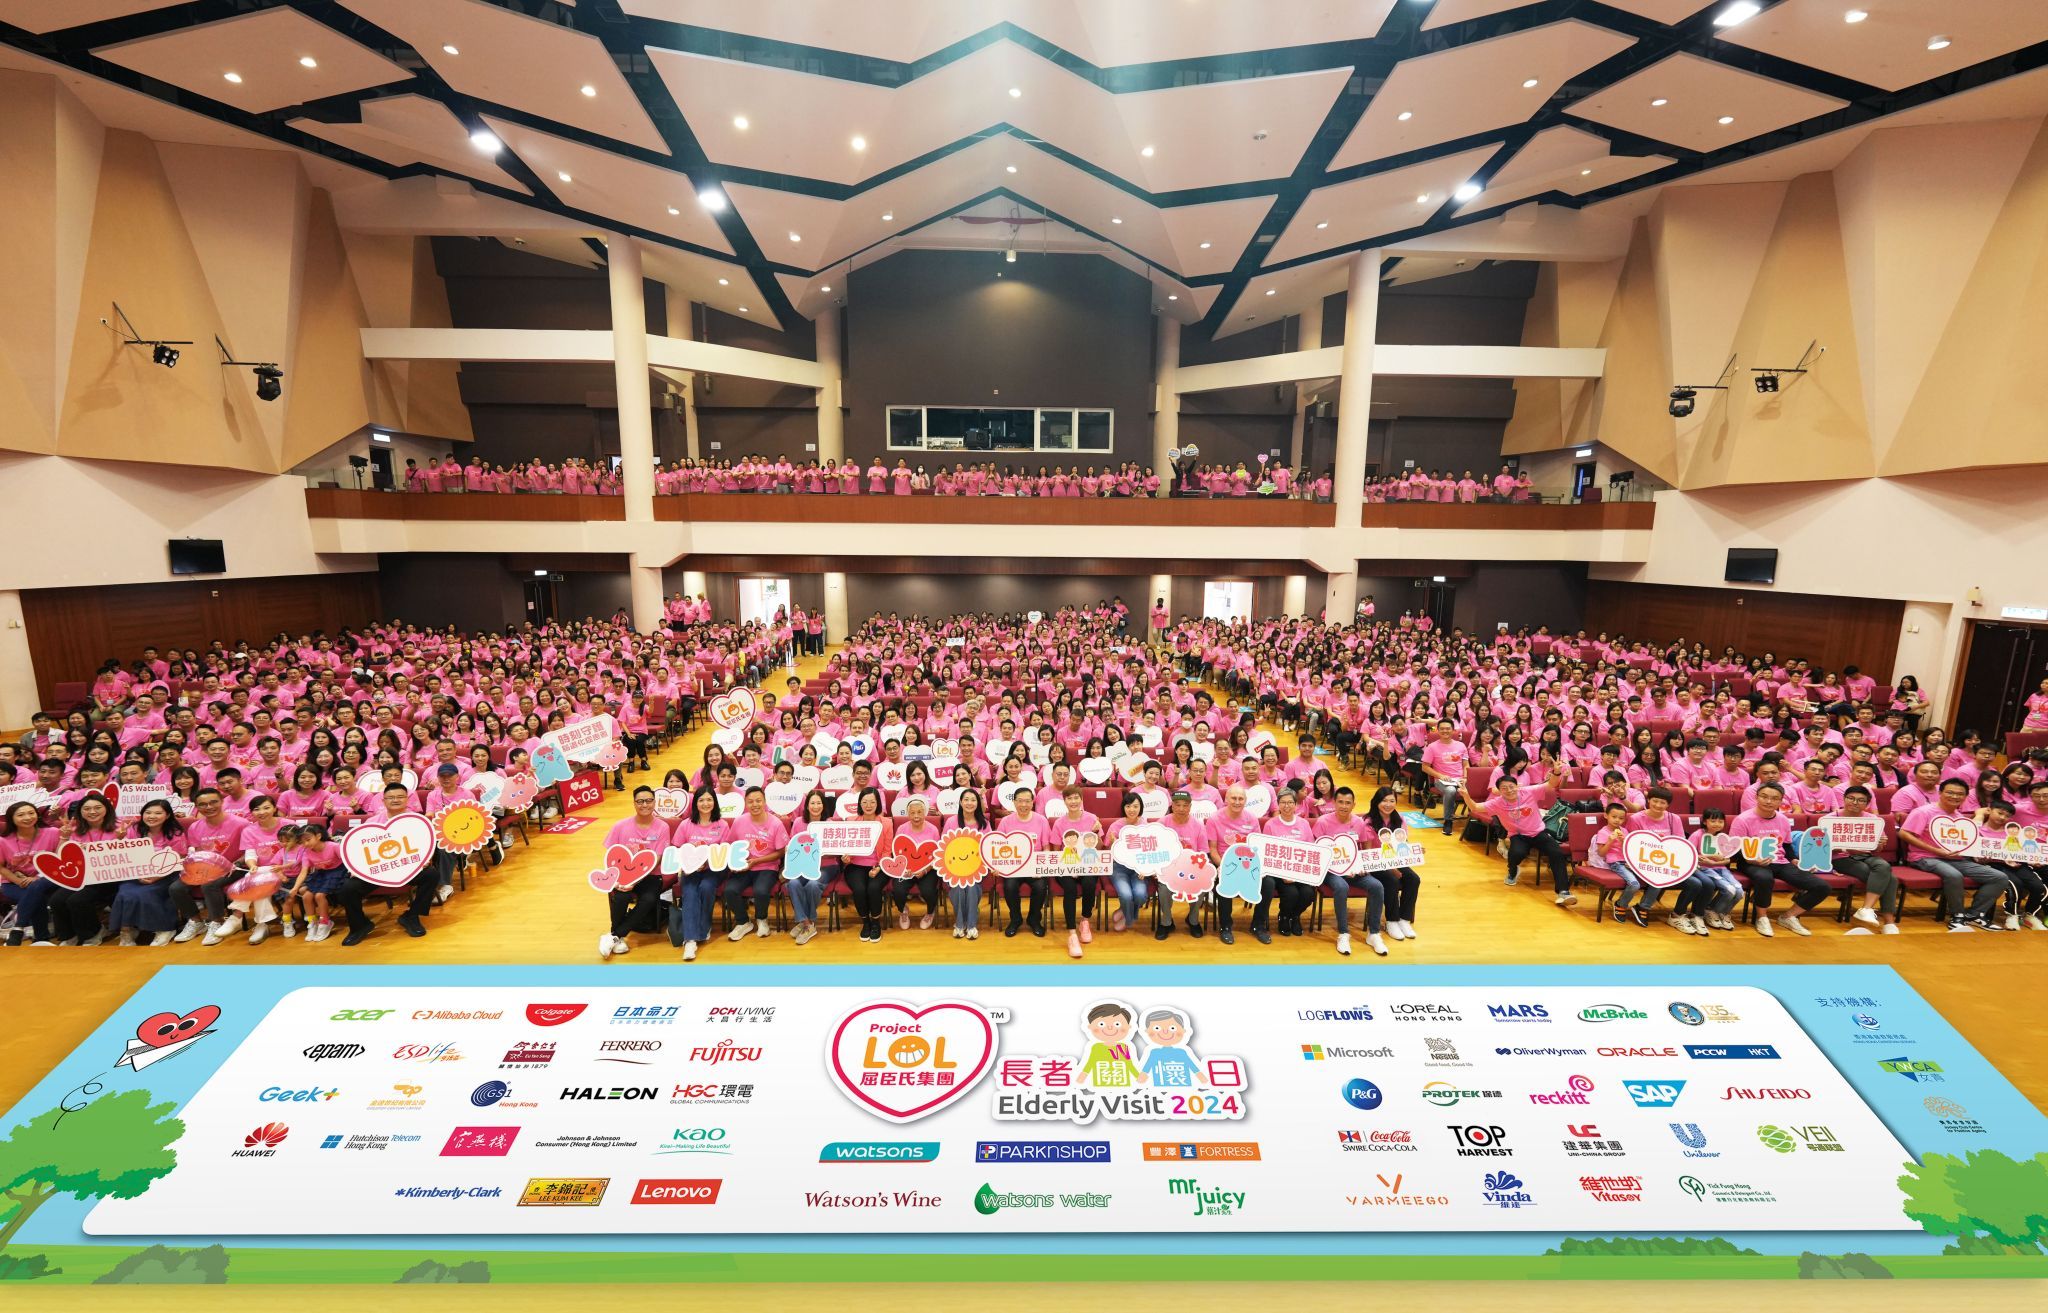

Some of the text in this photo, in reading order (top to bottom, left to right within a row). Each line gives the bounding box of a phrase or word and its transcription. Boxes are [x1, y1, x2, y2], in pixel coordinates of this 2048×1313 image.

[720, 701, 748, 720] LOL
[122, 785, 165, 793] AS Watson
[568, 788, 599, 808] A-03
[658, 798, 679, 808] LOL
[823, 828, 871, 839] 時刻守護
[1832, 823, 1875, 835] 時刻守護
[1941, 827, 1968, 840] LOL
[361, 833, 391, 844] Project
[1640, 840, 1664, 848] Project
[88, 838, 151, 854] AS Watson
[364, 836, 419, 865] LOL
[992, 846, 1022, 858] LOL
[1265, 843, 1320, 865] 時刻守護
[1639, 847, 1680, 869] LOL
[1981, 850, 2008, 860] Elderly
[2011, 853, 2027, 861] Visit
[90, 853, 132, 868] GLOBAL
[369, 854, 421, 875] 屈臣氏集團
[1264, 857, 1320, 876] 腦退化症患者
[1363, 857, 1421, 871] Elderly Visit 2024
[93, 864, 157, 881] VOLUNTEER
[1035, 867, 1065, 875] Elderly
[330, 1009, 396, 1021] acer
[433, 1010, 503, 1020] Alibaba Cloud
[534, 1008, 574, 1016] Colgate
[613, 1006, 679, 1016] 日本命力
[1298, 1010, 1373, 1021] LOGFLOWS
[1487, 1004, 1549, 1017] MARS
[1583, 1009, 1648, 1019] McBride
[870, 1023, 921, 1034] Project
[600, 1040, 662, 1051] FERRERO
[863, 1035, 957, 1068] LOL
[689, 1047, 763, 1066] FUJITSU
[1327, 1047, 1394, 1058] Microsoft
[1597, 1048, 1678, 1057] ORACLE
[1693, 1048, 1770, 1056] PCCW HKT
[1887, 1062, 1935, 1072] YWCA
[860, 1071, 954, 1086] 屈臣氏集團
[259, 1086, 340, 1102] Geek+
[487, 1089, 512, 1098] GS1
[560, 1087, 659, 1100] HALEON
[672, 1084, 754, 1098] HGC 環電
[1351, 1088, 1377, 1099] P&G
[1422, 1090, 1480, 1098] PROTEK
[1628, 1084, 1678, 1102] SAP
[1720, 1087, 1811, 1100] SHISEIDO
[1530, 1091, 1590, 1105] reckitt
[999, 1094, 1239, 1118] Elderly Visit 2024
[349, 1134, 421, 1142] Hutchison Telecom
[1447, 1125, 1506, 1147] TOP
[344, 1141, 388, 1150] Hong Kong
[1342, 1144, 1418, 1152] SWIRE COCA-COLA
[1561, 1140, 1623, 1150] 建華集團
[837, 1146, 924, 1158] watsons
[1001, 1146, 1107, 1159] PARKnSHOP
[1199, 1147, 1254, 1157] FORTRESS
[1457, 1149, 1513, 1157] HARVEST
[1683, 1150, 1720, 1158] Unilever
[544, 1183, 588, 1195] 李錦記
[1169, 1178, 1197, 1194] mr
[1579, 1176, 1642, 1191] 維他奶
[405, 1187, 502, 1199] Kimberly-Clark
[641, 1184, 711, 1198] Lenovo
[1482, 1191, 1532, 1202] Vinda
[1591, 1192, 1642, 1202] Vitasoy
[805, 1191, 942, 1207] Watson's Wine
[981, 1192, 1112, 1207] watsons water
[1194, 1187, 1245, 1215] juicy
[1346, 1196, 1449, 1205] VARMEEGO
